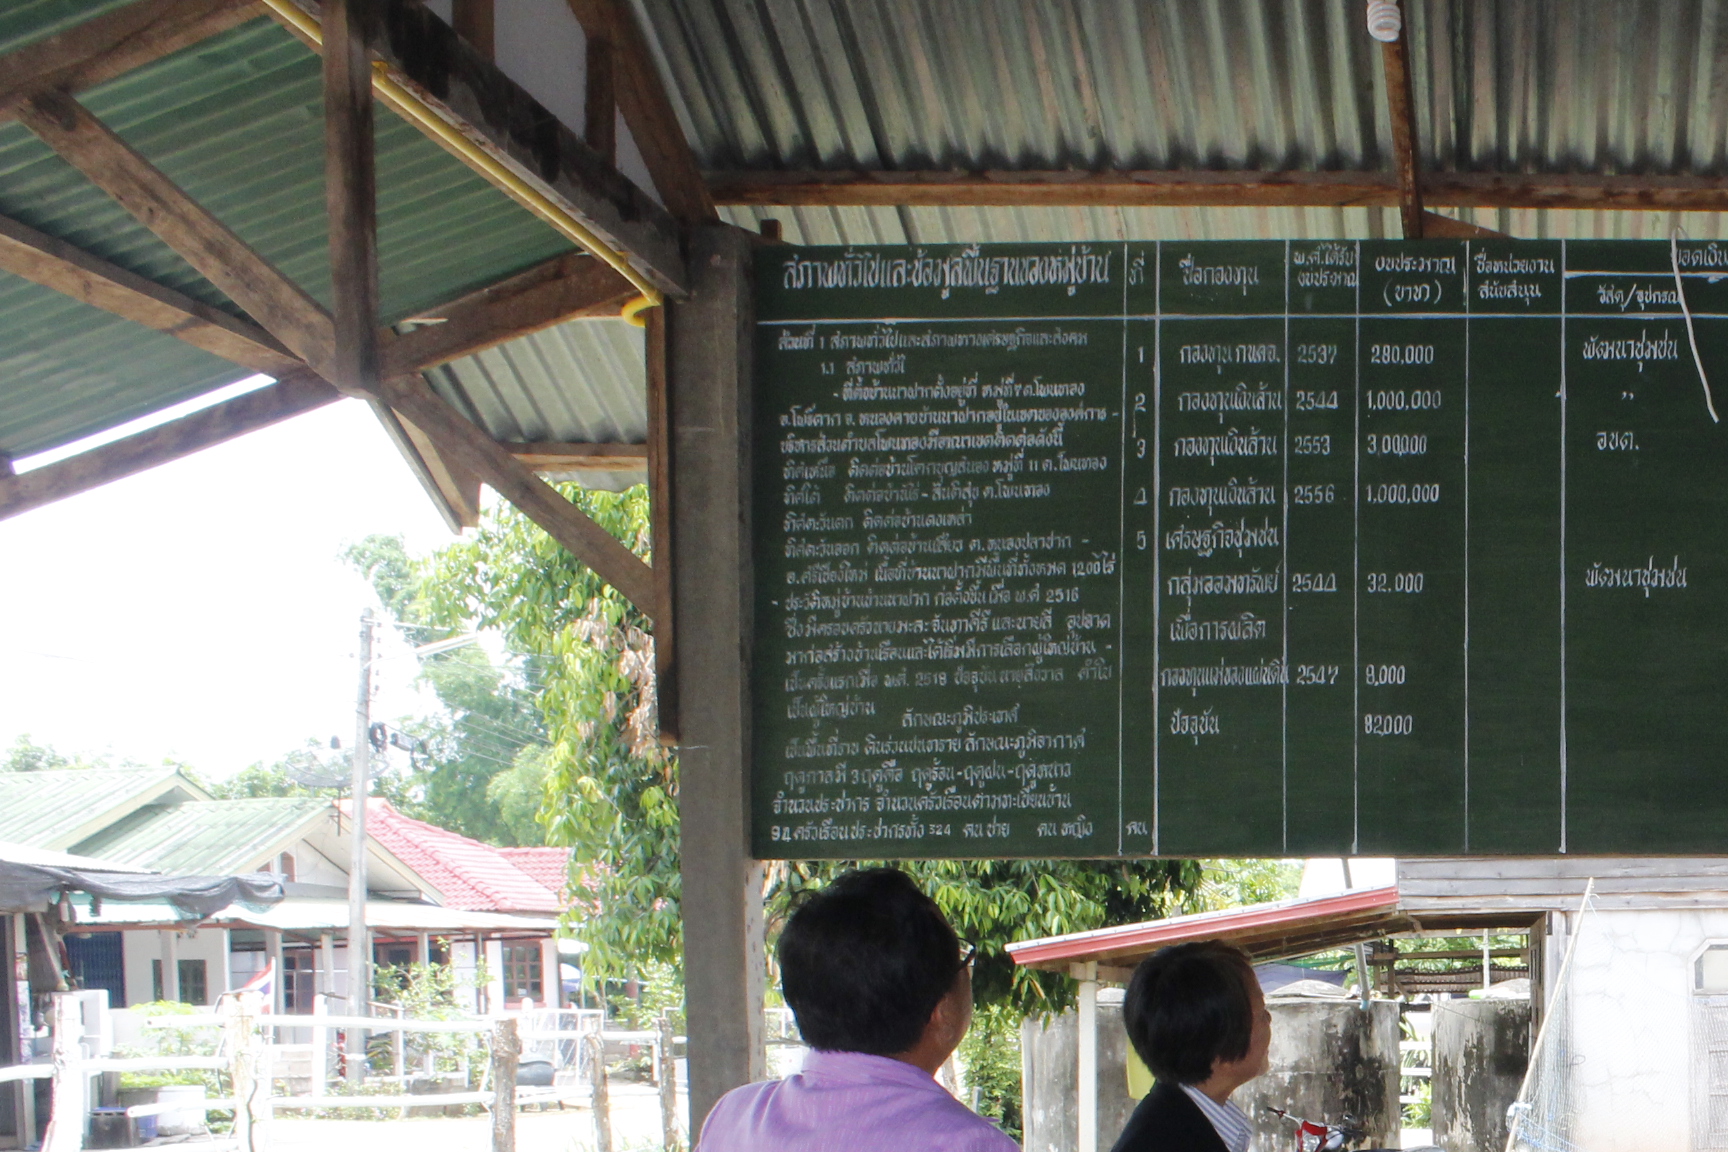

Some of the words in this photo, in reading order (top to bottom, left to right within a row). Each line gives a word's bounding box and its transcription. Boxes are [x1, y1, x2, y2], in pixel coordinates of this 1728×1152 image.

[1179, 253, 1259, 296] ชื่อกองทุน
[1375, 252, 1456, 274] งบประมาณ
[1474, 248, 1555, 274] ชื่อหน่วยงาน
[1479, 280, 1541, 305] สนับสนุน
[1180, 344, 1233, 375] กองทุน
[1583, 328, 1678, 372] พัฒนาชุมชน
[1178, 381, 1282, 424] กองทุนเงินล้าน
[1174, 426, 1277, 466] กองทุนเงินล้าน
[1169, 477, 1276, 516] กองทุนเงินล้าน
[1585, 555, 1688, 598] พัฒนาชุมชน
[1170, 612, 1266, 642] เพื่อการผลิต
[1170, 705, 1220, 745] ปัจจุบัน
